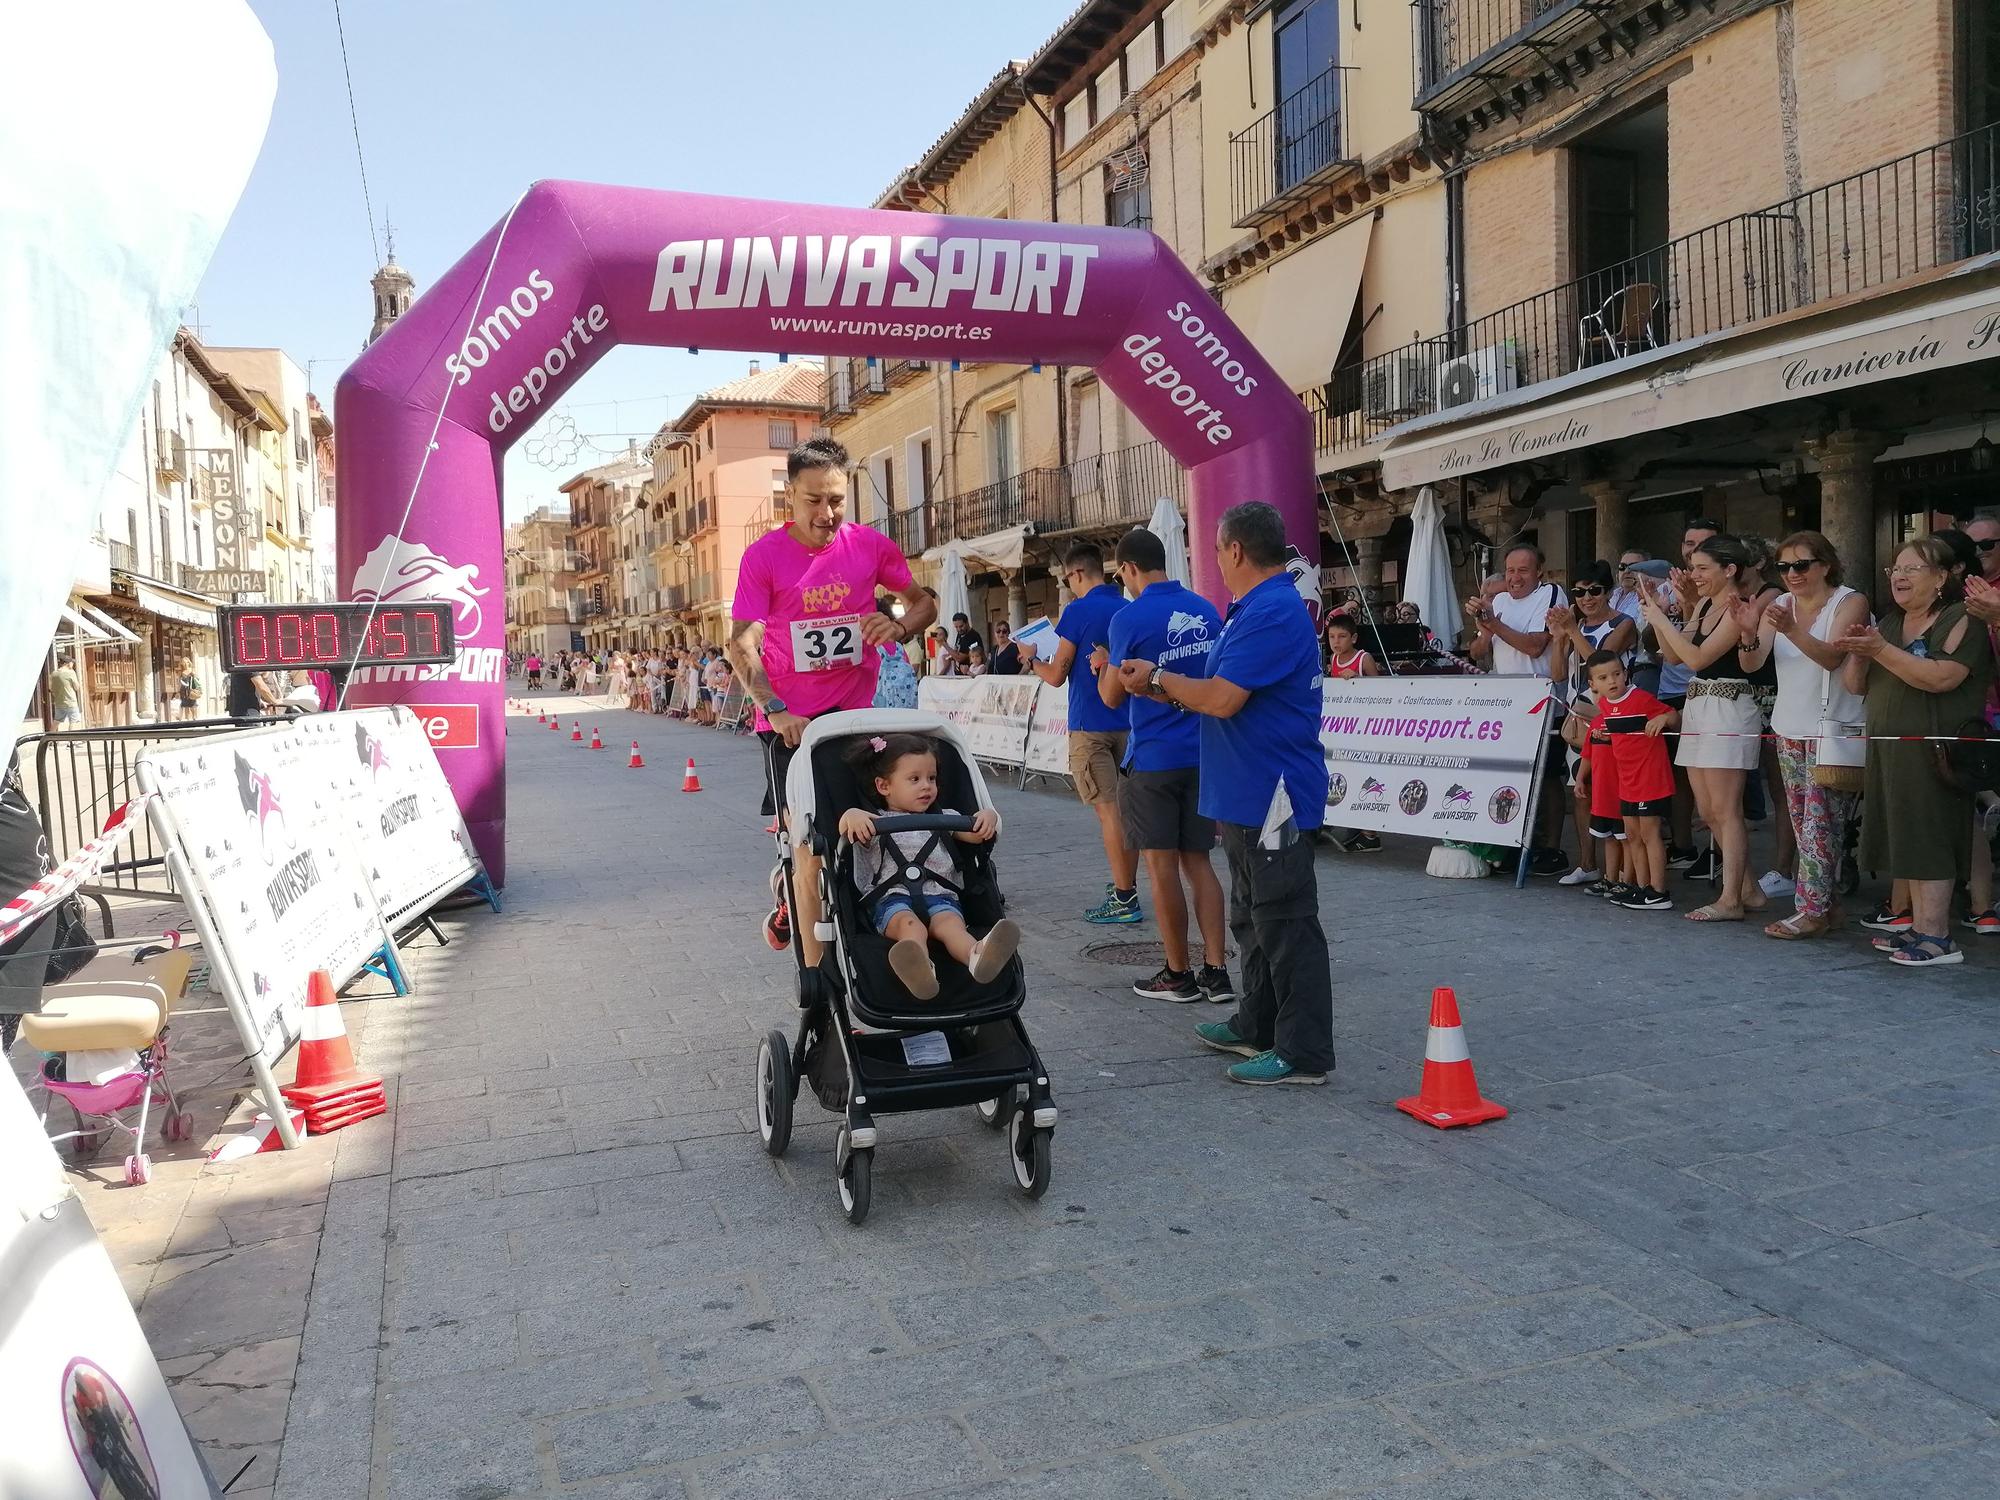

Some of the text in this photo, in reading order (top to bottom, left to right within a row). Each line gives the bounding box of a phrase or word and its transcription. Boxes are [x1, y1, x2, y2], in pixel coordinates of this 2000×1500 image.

[648, 234, 1099, 317] RUNVASPORT
[445, 268, 554, 386] somos
[769, 316, 993, 342] www.runvasport.es
[1166, 301, 1258, 397] somos
[488, 303, 609, 433] deporte
[1122, 334, 1232, 446] deporte
[1781, 334, 1949, 391] Carnicería
[1439, 450, 1474, 472] Bar
[1509, 417, 1593, 455] Comedia
[195, 573, 262, 592] ZAMORA
[803, 626, 854, 659] 32
[1380, 754, 1391, 764] DE
[1391, 754, 1423, 766] EVENTOS
[1423, 756, 1470, 769] DEPORTIVOS
